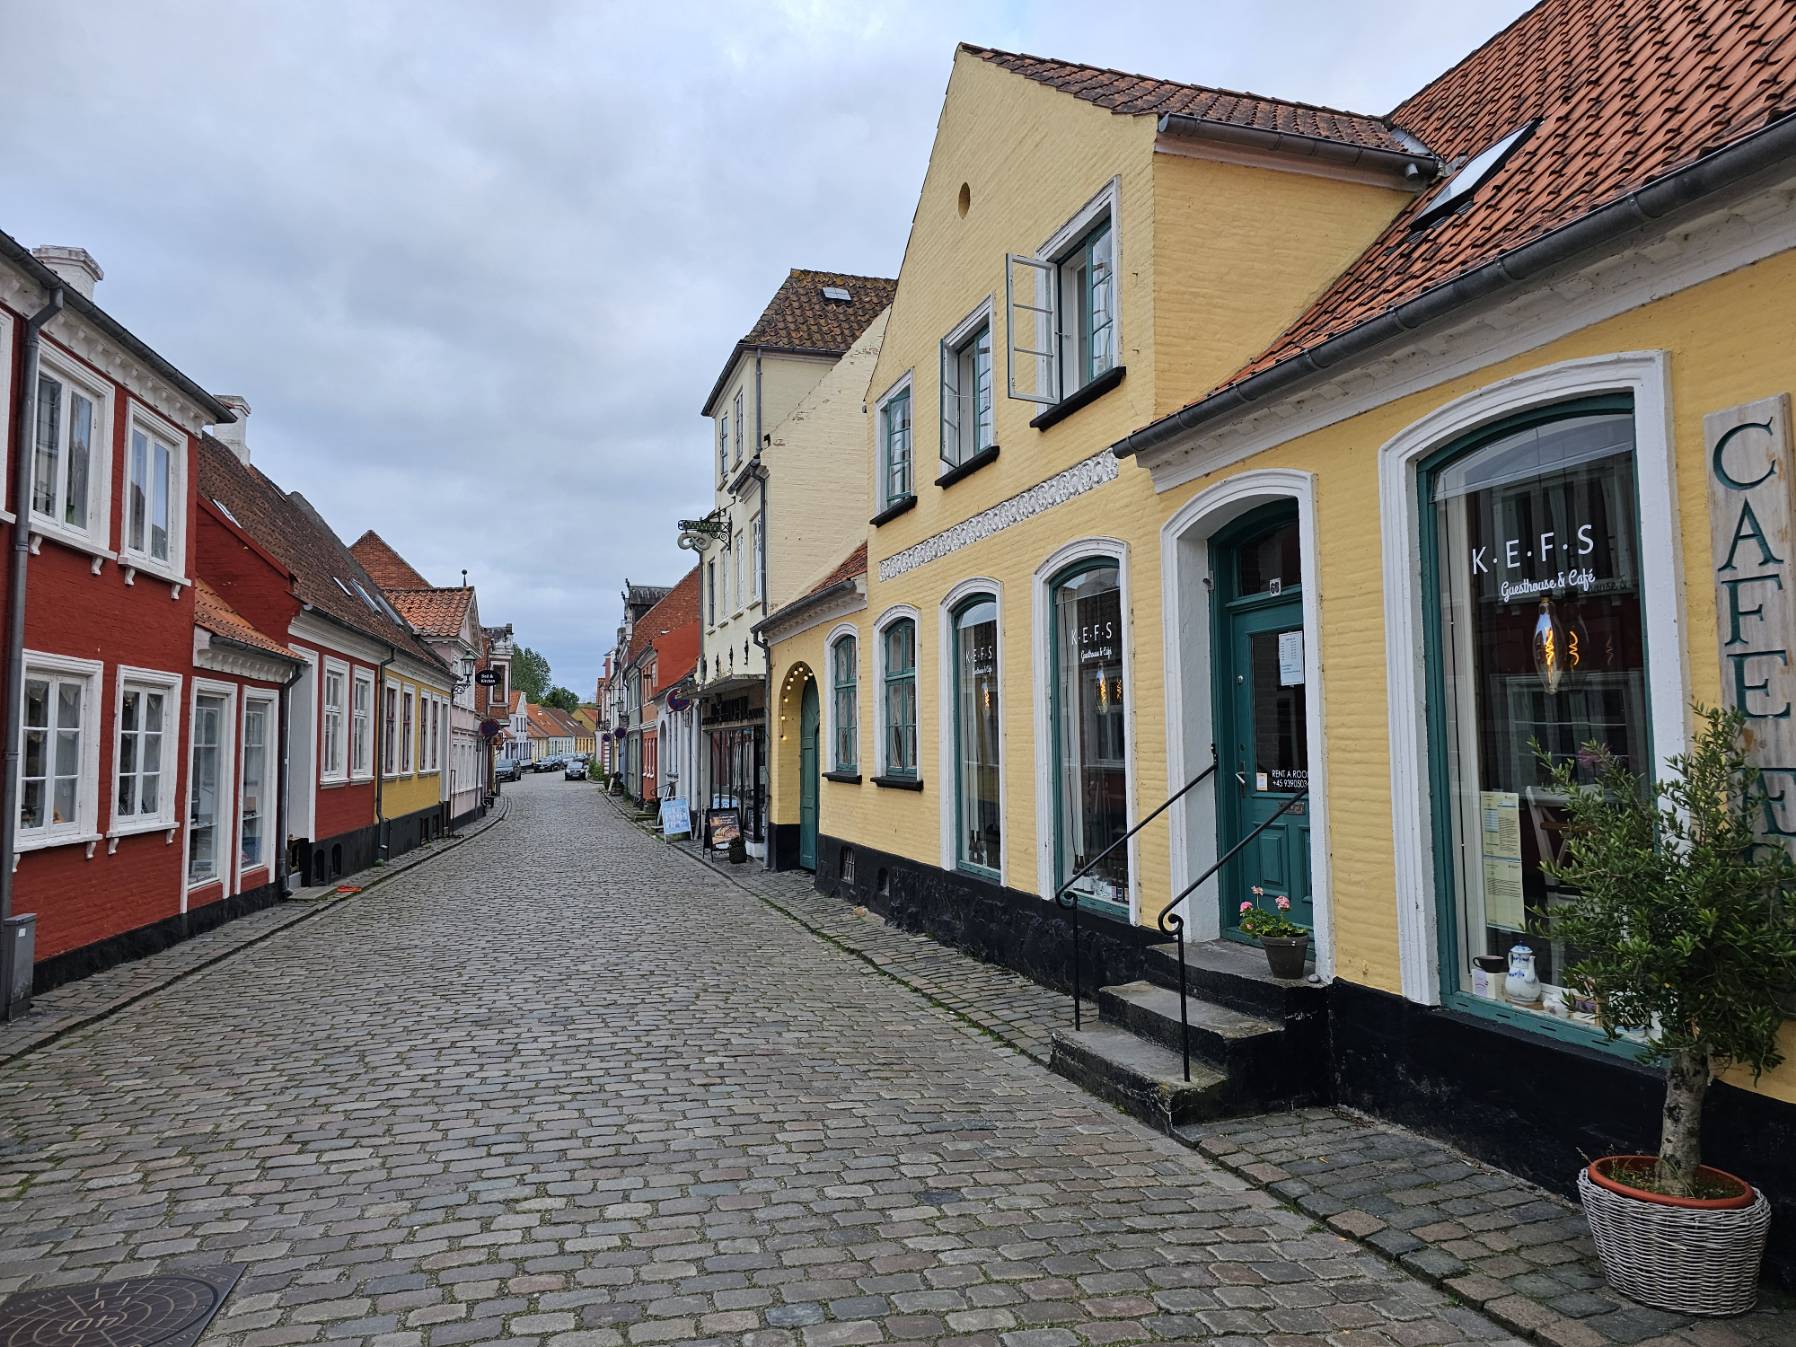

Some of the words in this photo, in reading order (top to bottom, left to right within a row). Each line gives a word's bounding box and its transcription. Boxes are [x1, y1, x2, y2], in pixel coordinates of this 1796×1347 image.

[1501, 579, 1556, 603] Guesthouse
[1557, 571, 1566, 588] &
[1568, 567, 1596, 591] Café
[1712, 415, 1791, 720] CAFE
[1271, 769, 1286, 778] RENT
[1286, 769, 1292, 778] A
[1293, 769, 1308, 778] ROO
